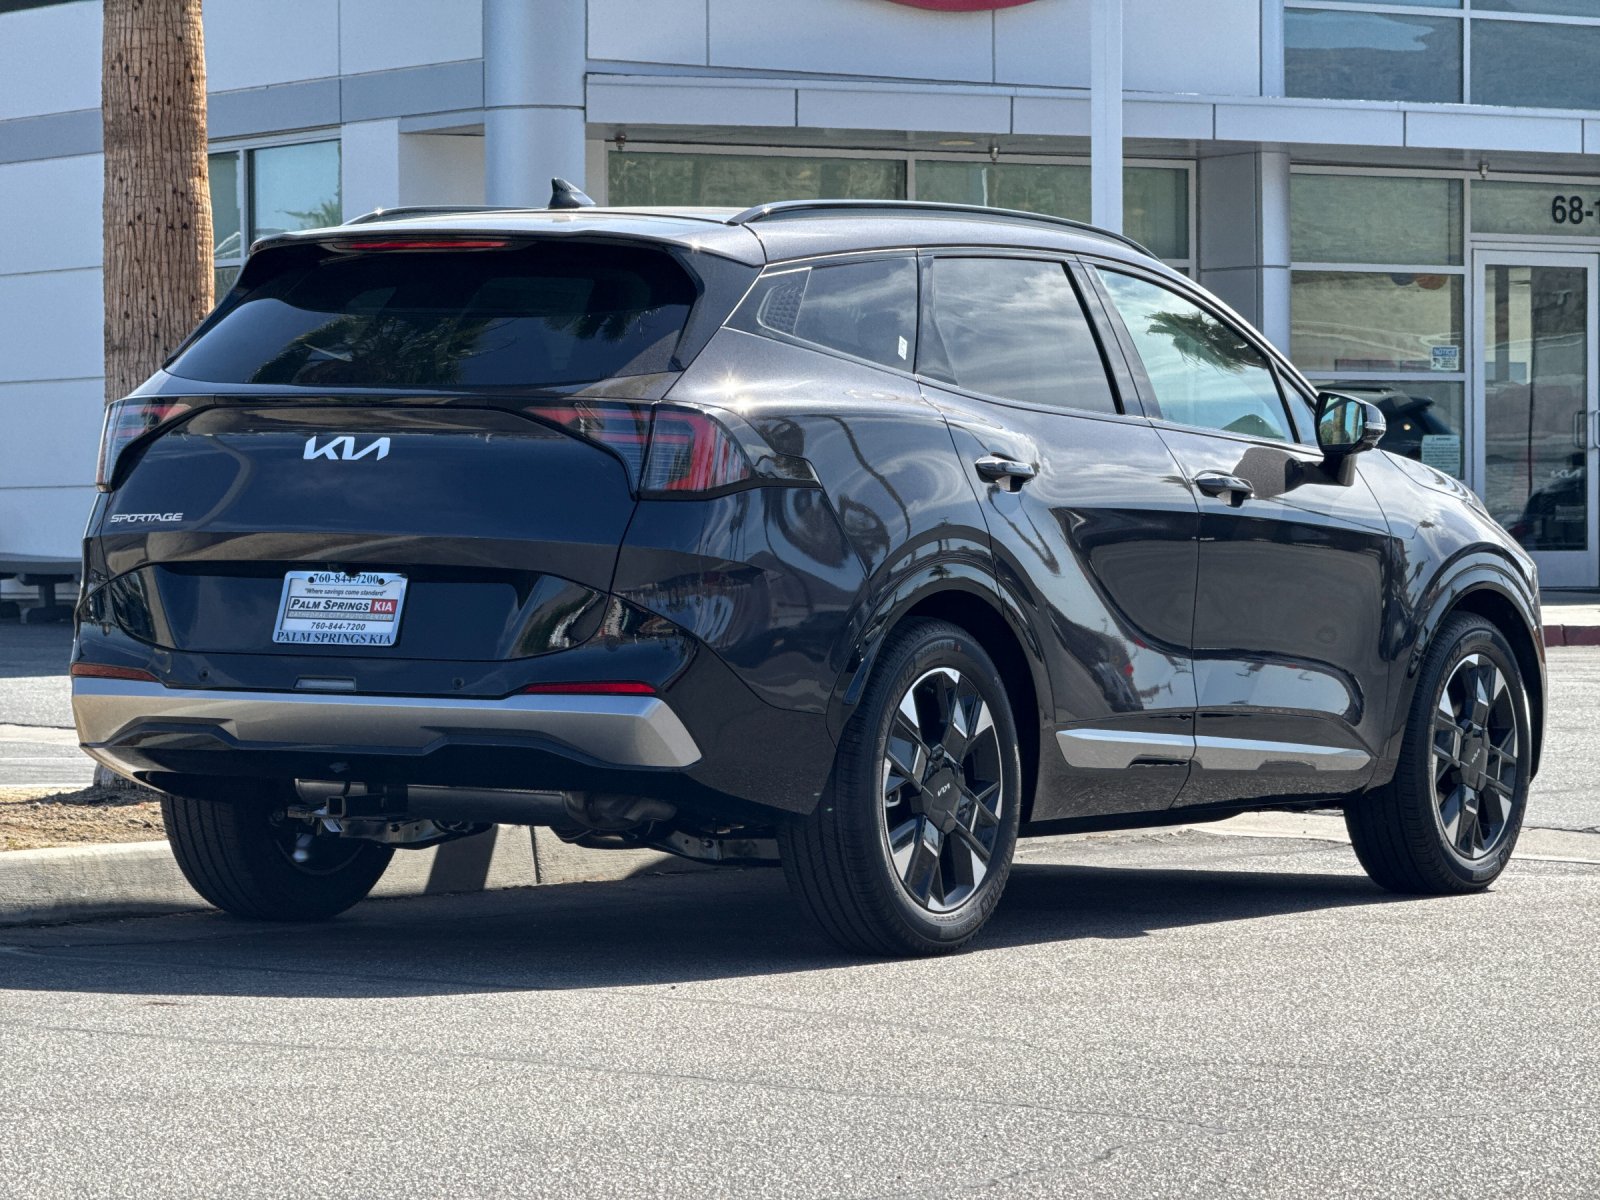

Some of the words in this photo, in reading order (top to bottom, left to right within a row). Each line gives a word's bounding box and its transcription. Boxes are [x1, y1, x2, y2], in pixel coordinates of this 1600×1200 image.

[303, 435, 391, 461] KIA
[110, 512, 184, 523] SPORTAGE
[313, 573, 379, 585] 760-844-7200
[324, 589, 343, 597] savings
[290, 598, 321, 609] PALM
[323, 599, 370, 611] SPRINGS
[374, 601, 393, 612] KIA
[311, 621, 366, 631] 760-844-7200
[276, 631, 311, 642] PALM
[314, 632, 367, 645] SPRINGS
[368, 634, 392, 645] KIA
